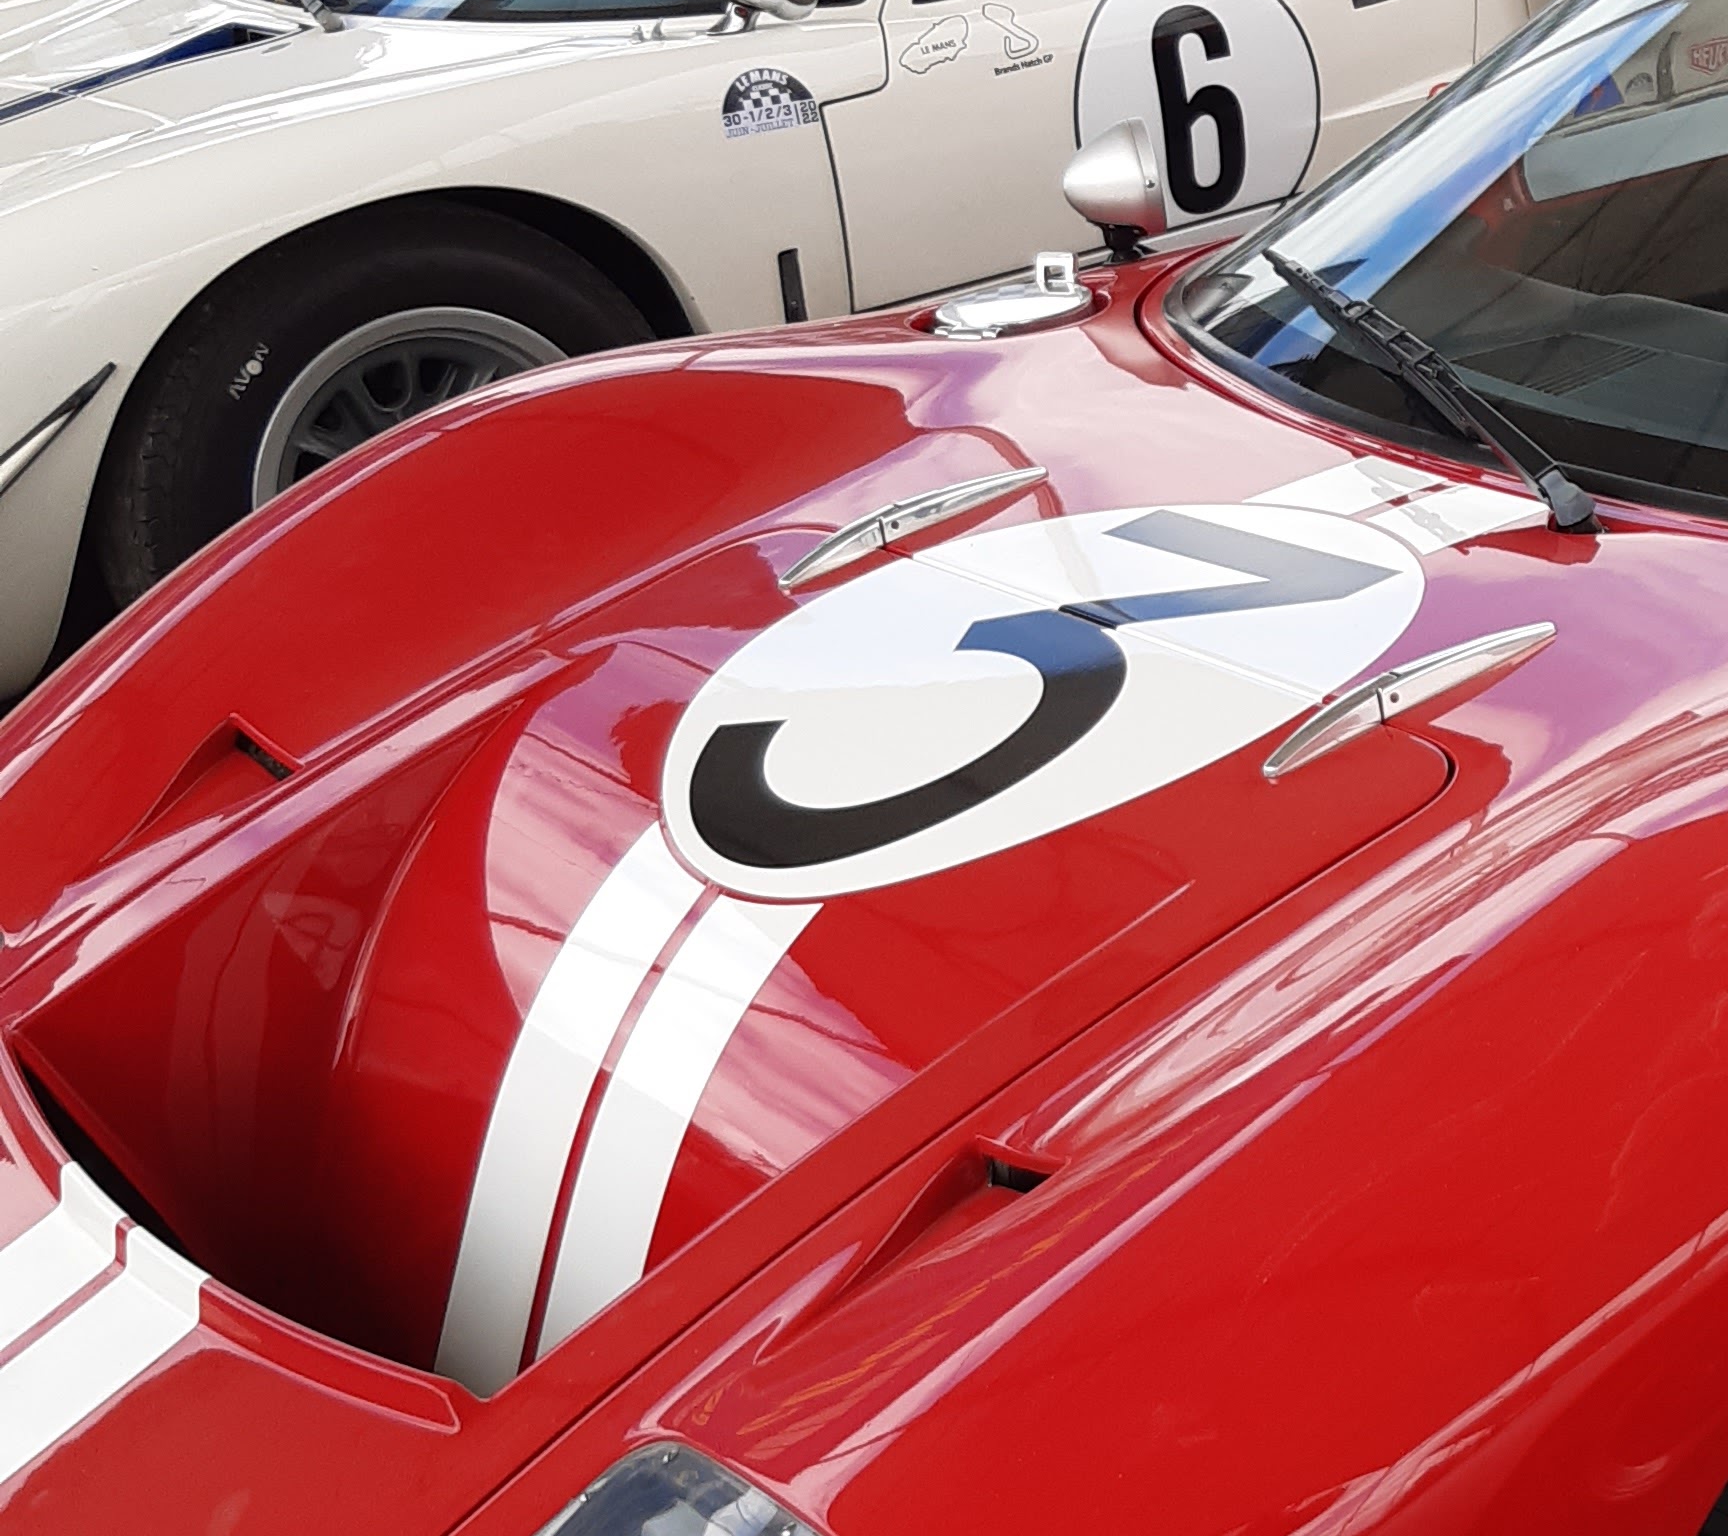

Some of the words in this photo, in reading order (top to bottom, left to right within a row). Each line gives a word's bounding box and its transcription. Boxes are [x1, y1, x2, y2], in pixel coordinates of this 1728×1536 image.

[920, 46, 931, 56] LE
[931, 39, 958, 53] MANS
[735, 75, 751, 93] LE
[749, 69, 789, 86] MANS
[994, 62, 1021, 77] Brands
[1151, 4, 1247, 215] 6
[228, 341, 270, 401] AVON
[688, 509, 1404, 869] 3
